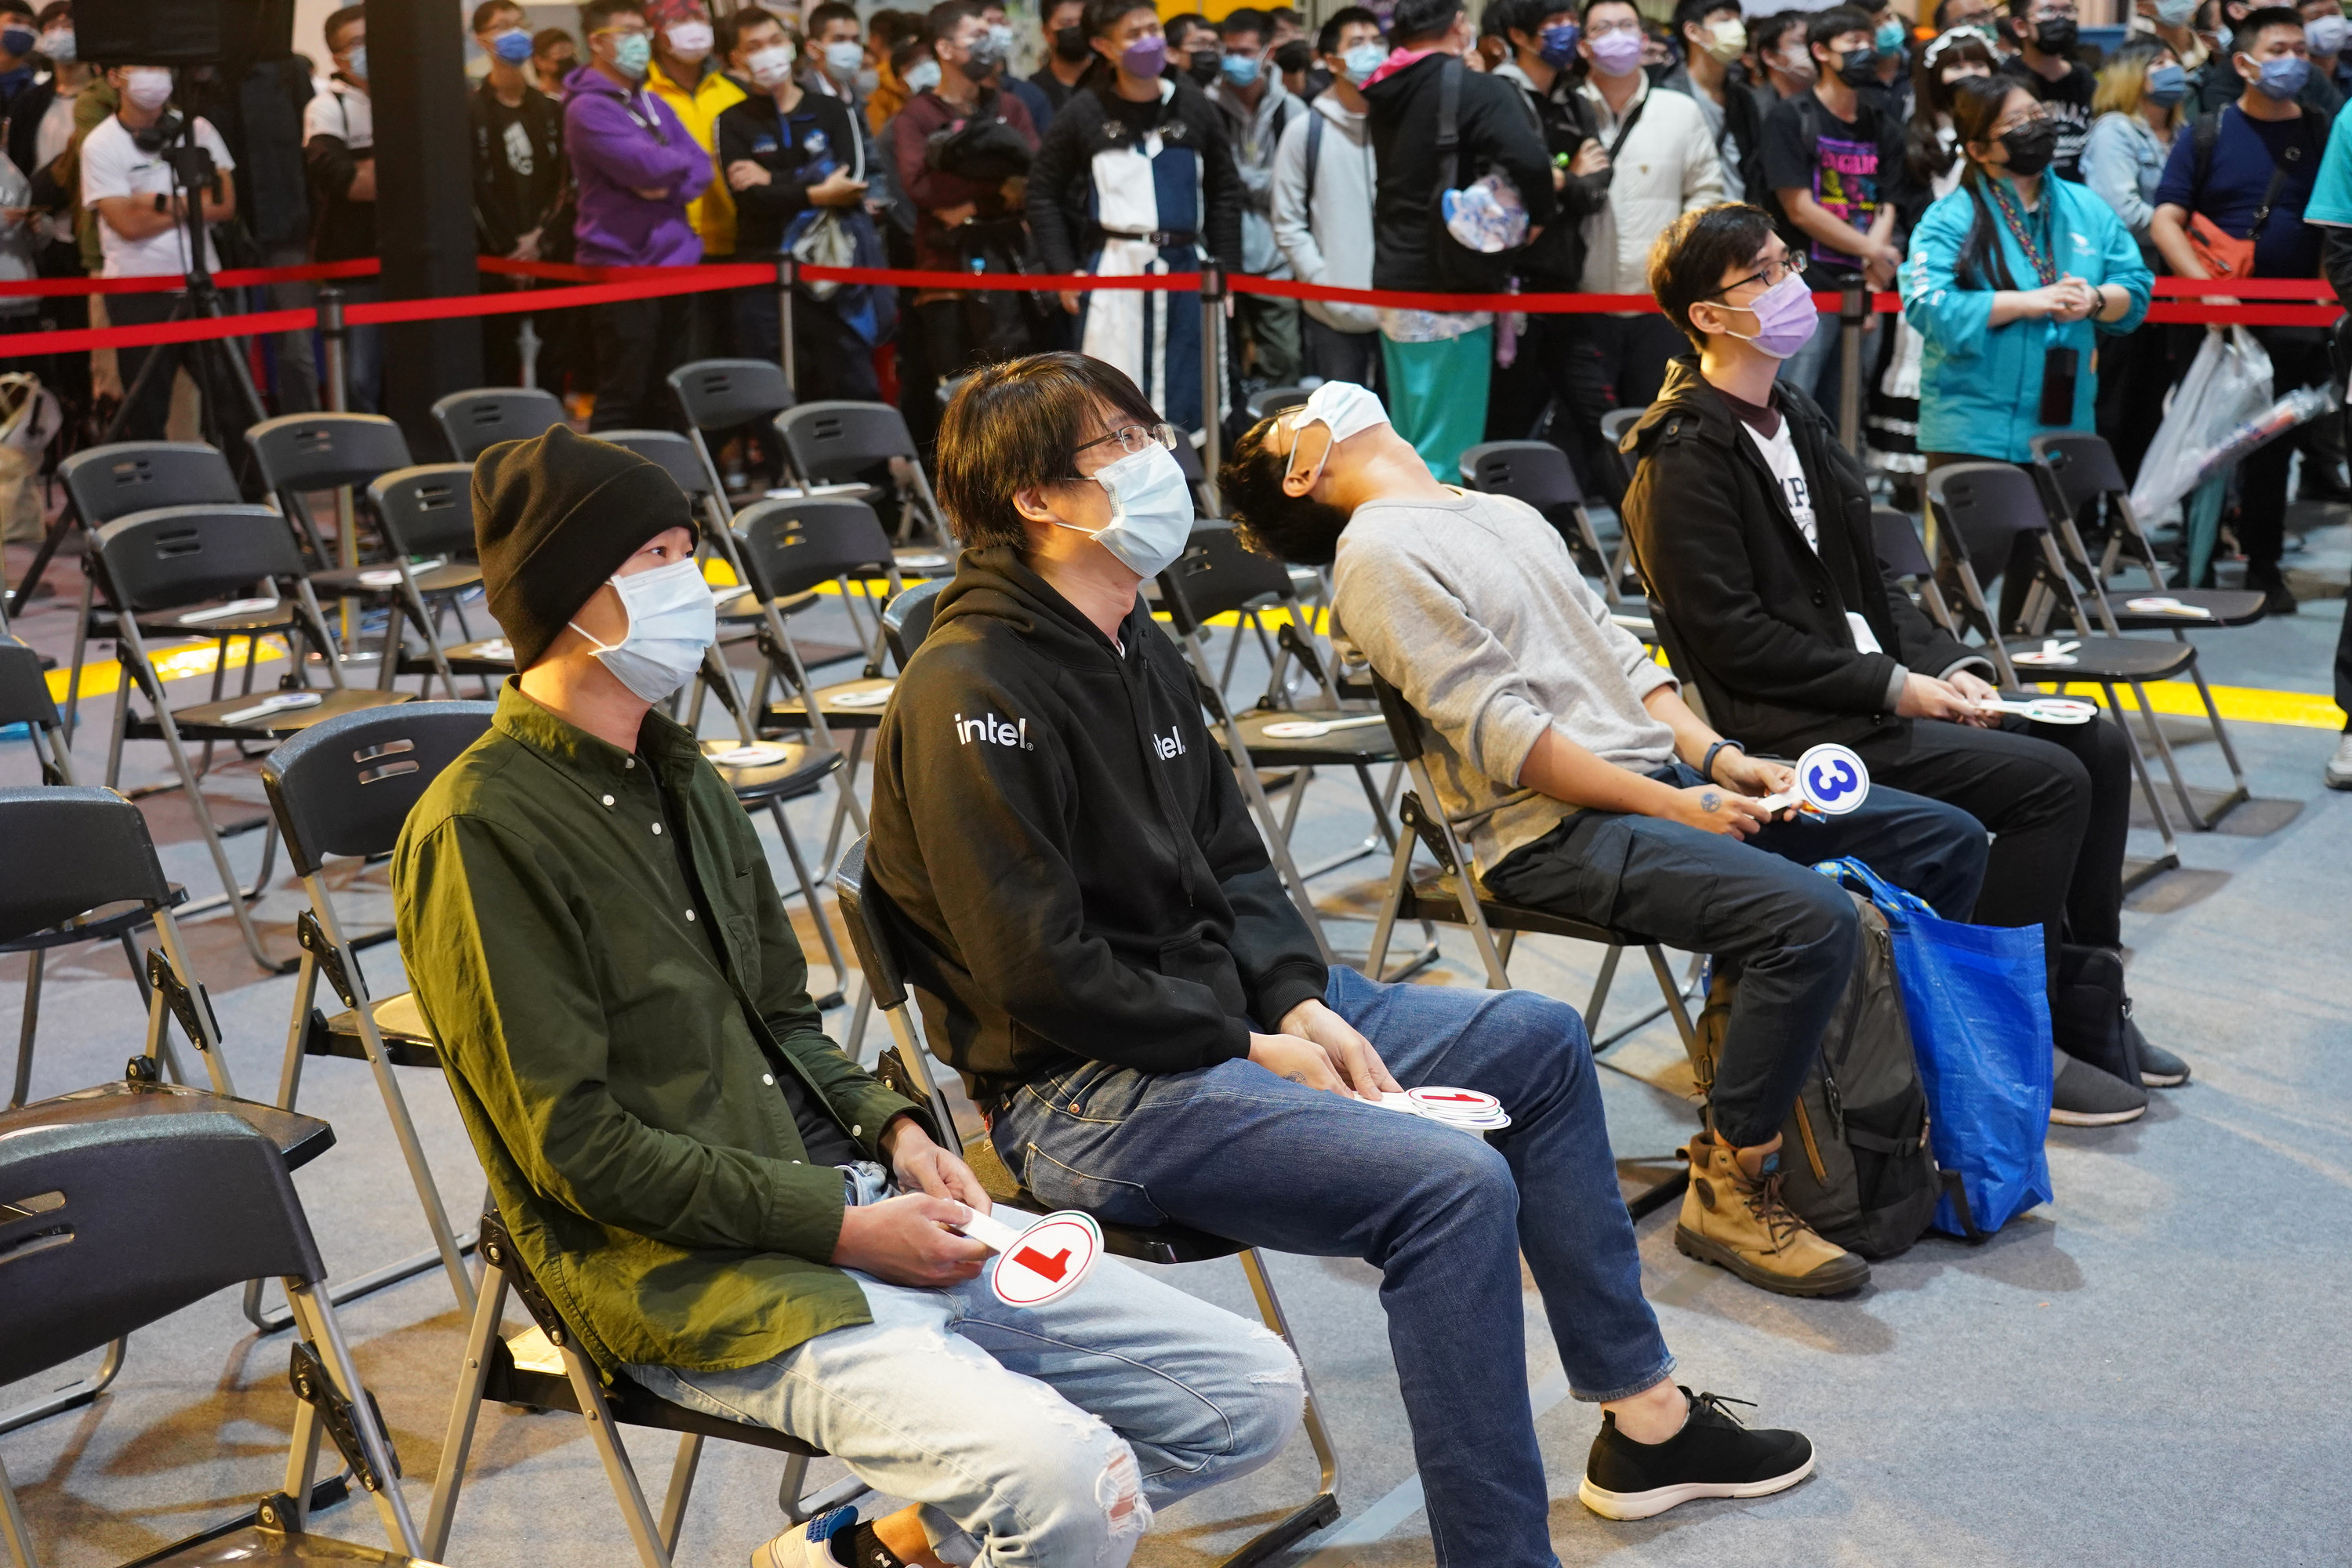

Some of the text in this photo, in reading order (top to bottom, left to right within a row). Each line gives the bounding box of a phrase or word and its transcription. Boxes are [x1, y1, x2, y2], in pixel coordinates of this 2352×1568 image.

[1808, 759, 1858, 802] 3
[1420, 1093, 1486, 1103] 1
[1011, 1245, 1073, 1283] 1
